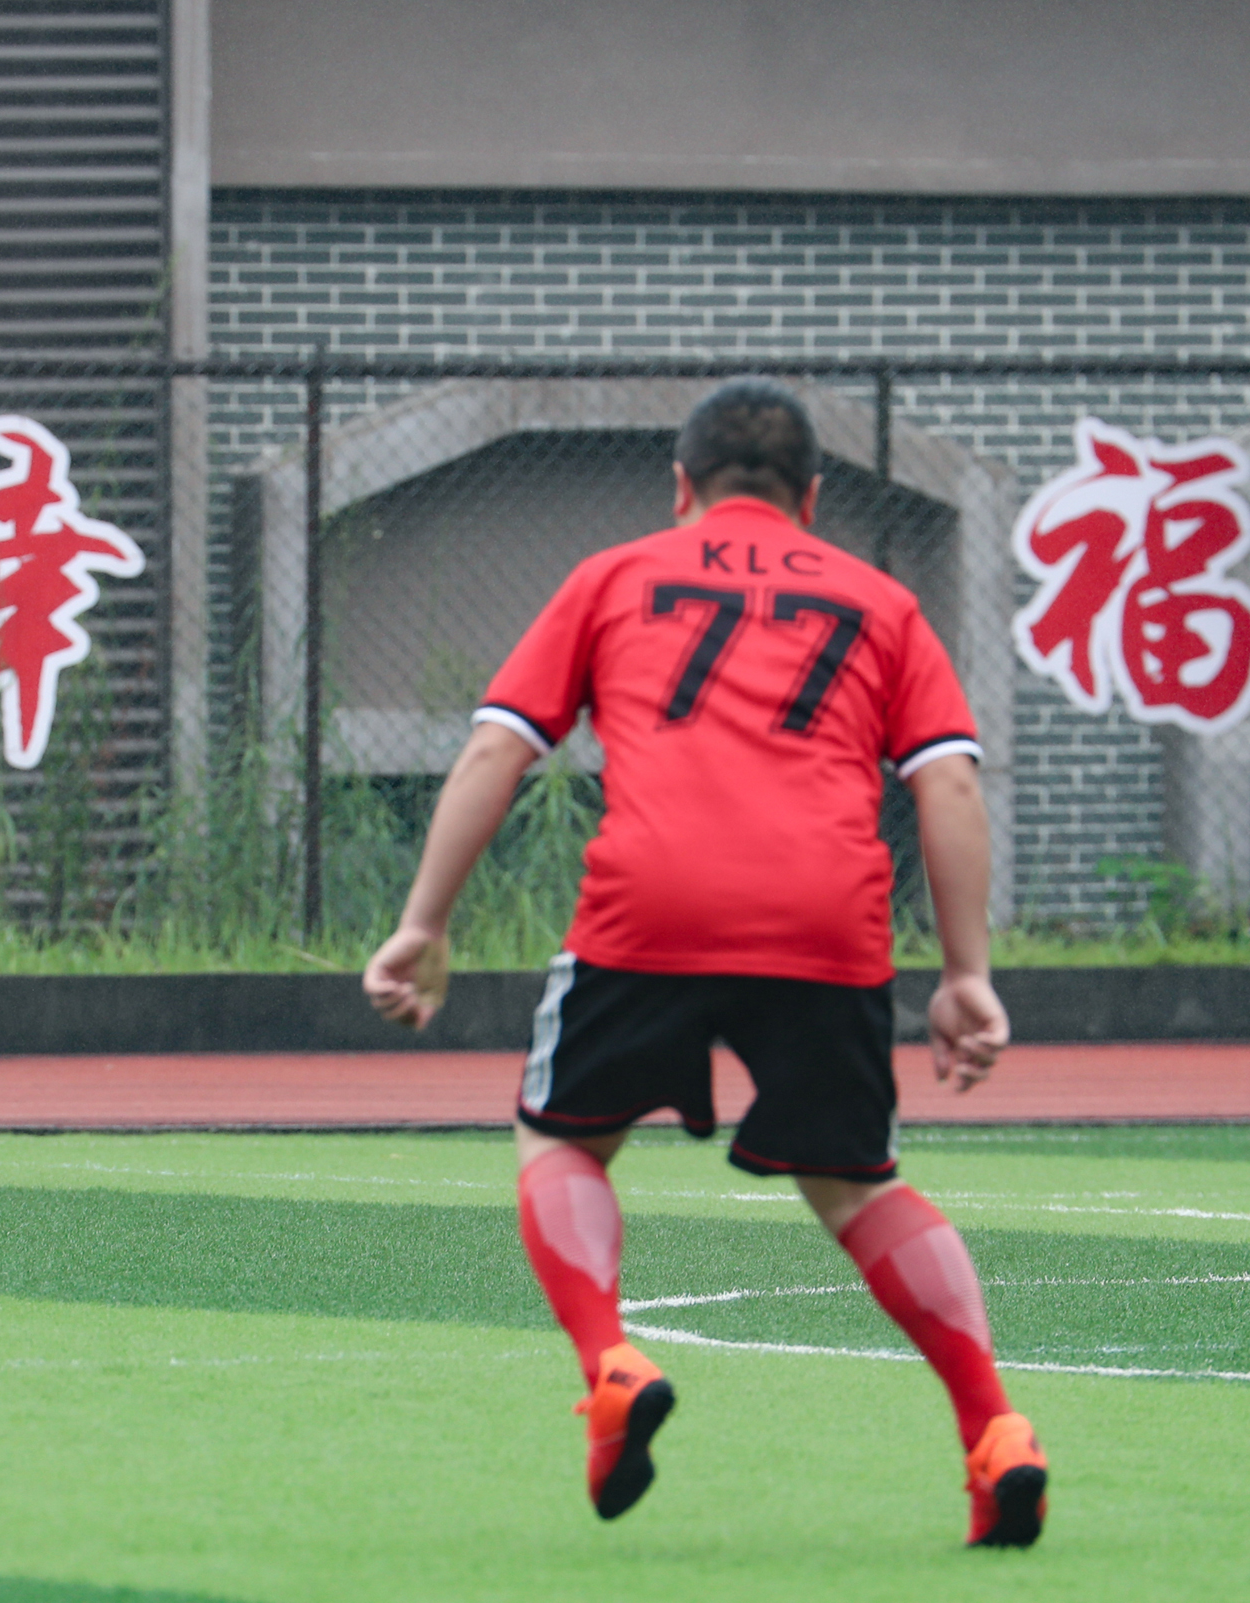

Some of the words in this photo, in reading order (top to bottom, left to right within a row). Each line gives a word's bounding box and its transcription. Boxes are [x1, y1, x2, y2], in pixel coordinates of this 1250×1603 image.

[702, 539, 823, 577] KLC
[1026, 432, 1250, 721] 福
[643, 580, 868, 738] 77
